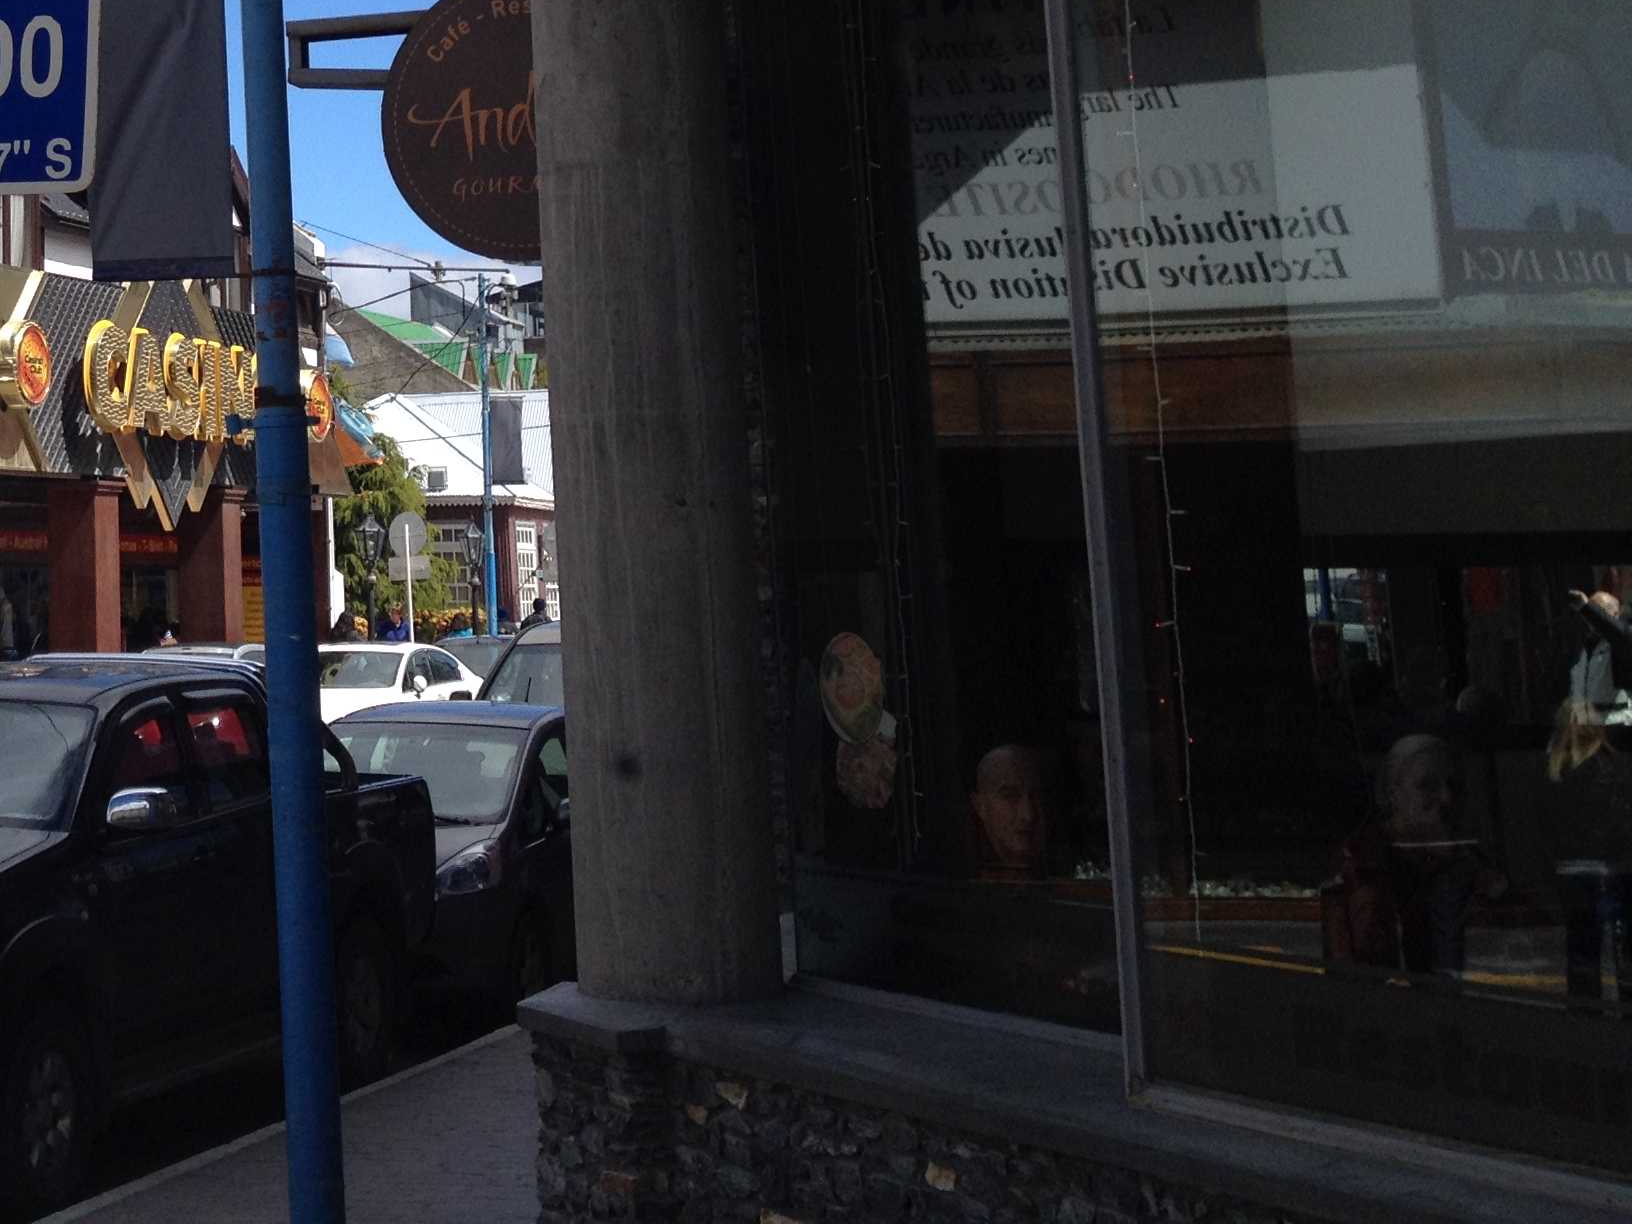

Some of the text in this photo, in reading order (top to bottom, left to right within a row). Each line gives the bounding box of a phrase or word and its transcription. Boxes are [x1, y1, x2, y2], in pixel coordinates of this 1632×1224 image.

[427, 14, 472, 63] Café
[407, 71, 538, 163] And
[45, 137, 73, 180] S
[453, 178, 542, 202] GOUR
[83, 319, 257, 445] CASIN
